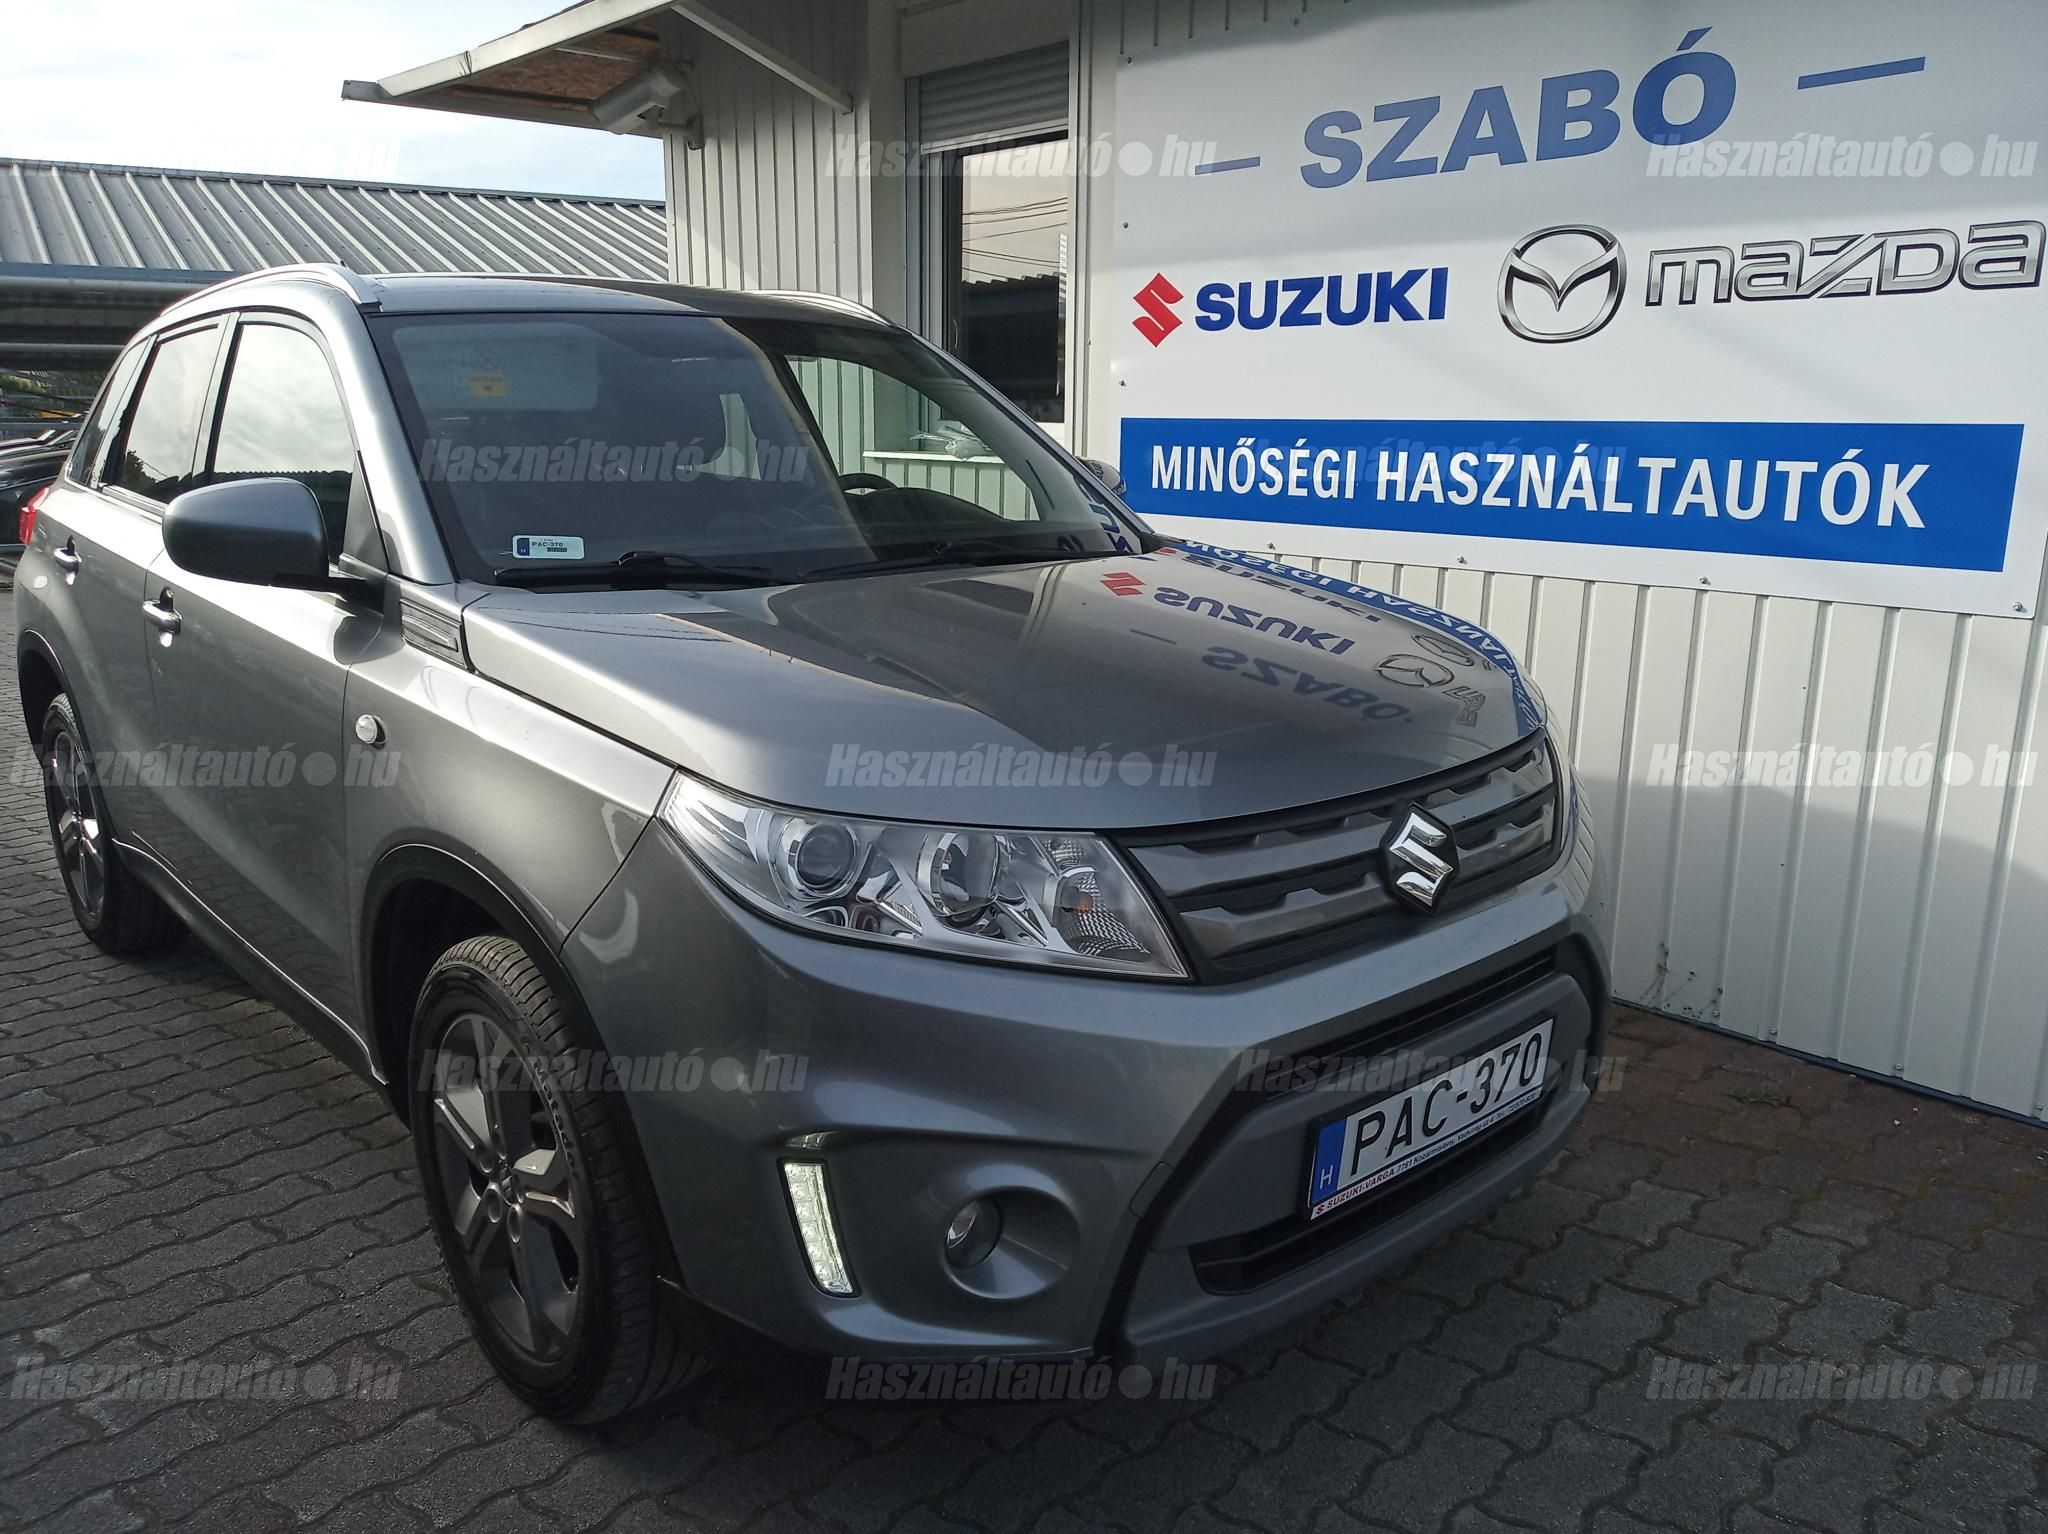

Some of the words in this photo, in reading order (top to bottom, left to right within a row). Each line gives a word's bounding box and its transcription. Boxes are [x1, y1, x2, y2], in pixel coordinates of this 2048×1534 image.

[1300, 26, 1737, 189] SZABÓ
[1195, 267, 1449, 331] SUZUKI
[1151, 437, 1357, 500] MINŐSÉGI
[1376, 442, 1931, 529] HASZNÁLTAUTÓK
[1350, 1032, 1543, 1177] PAC-370
[1319, 1164, 1334, 1189] H
[1327, 1168, 1395, 1209] SUZUKI-VARGA
